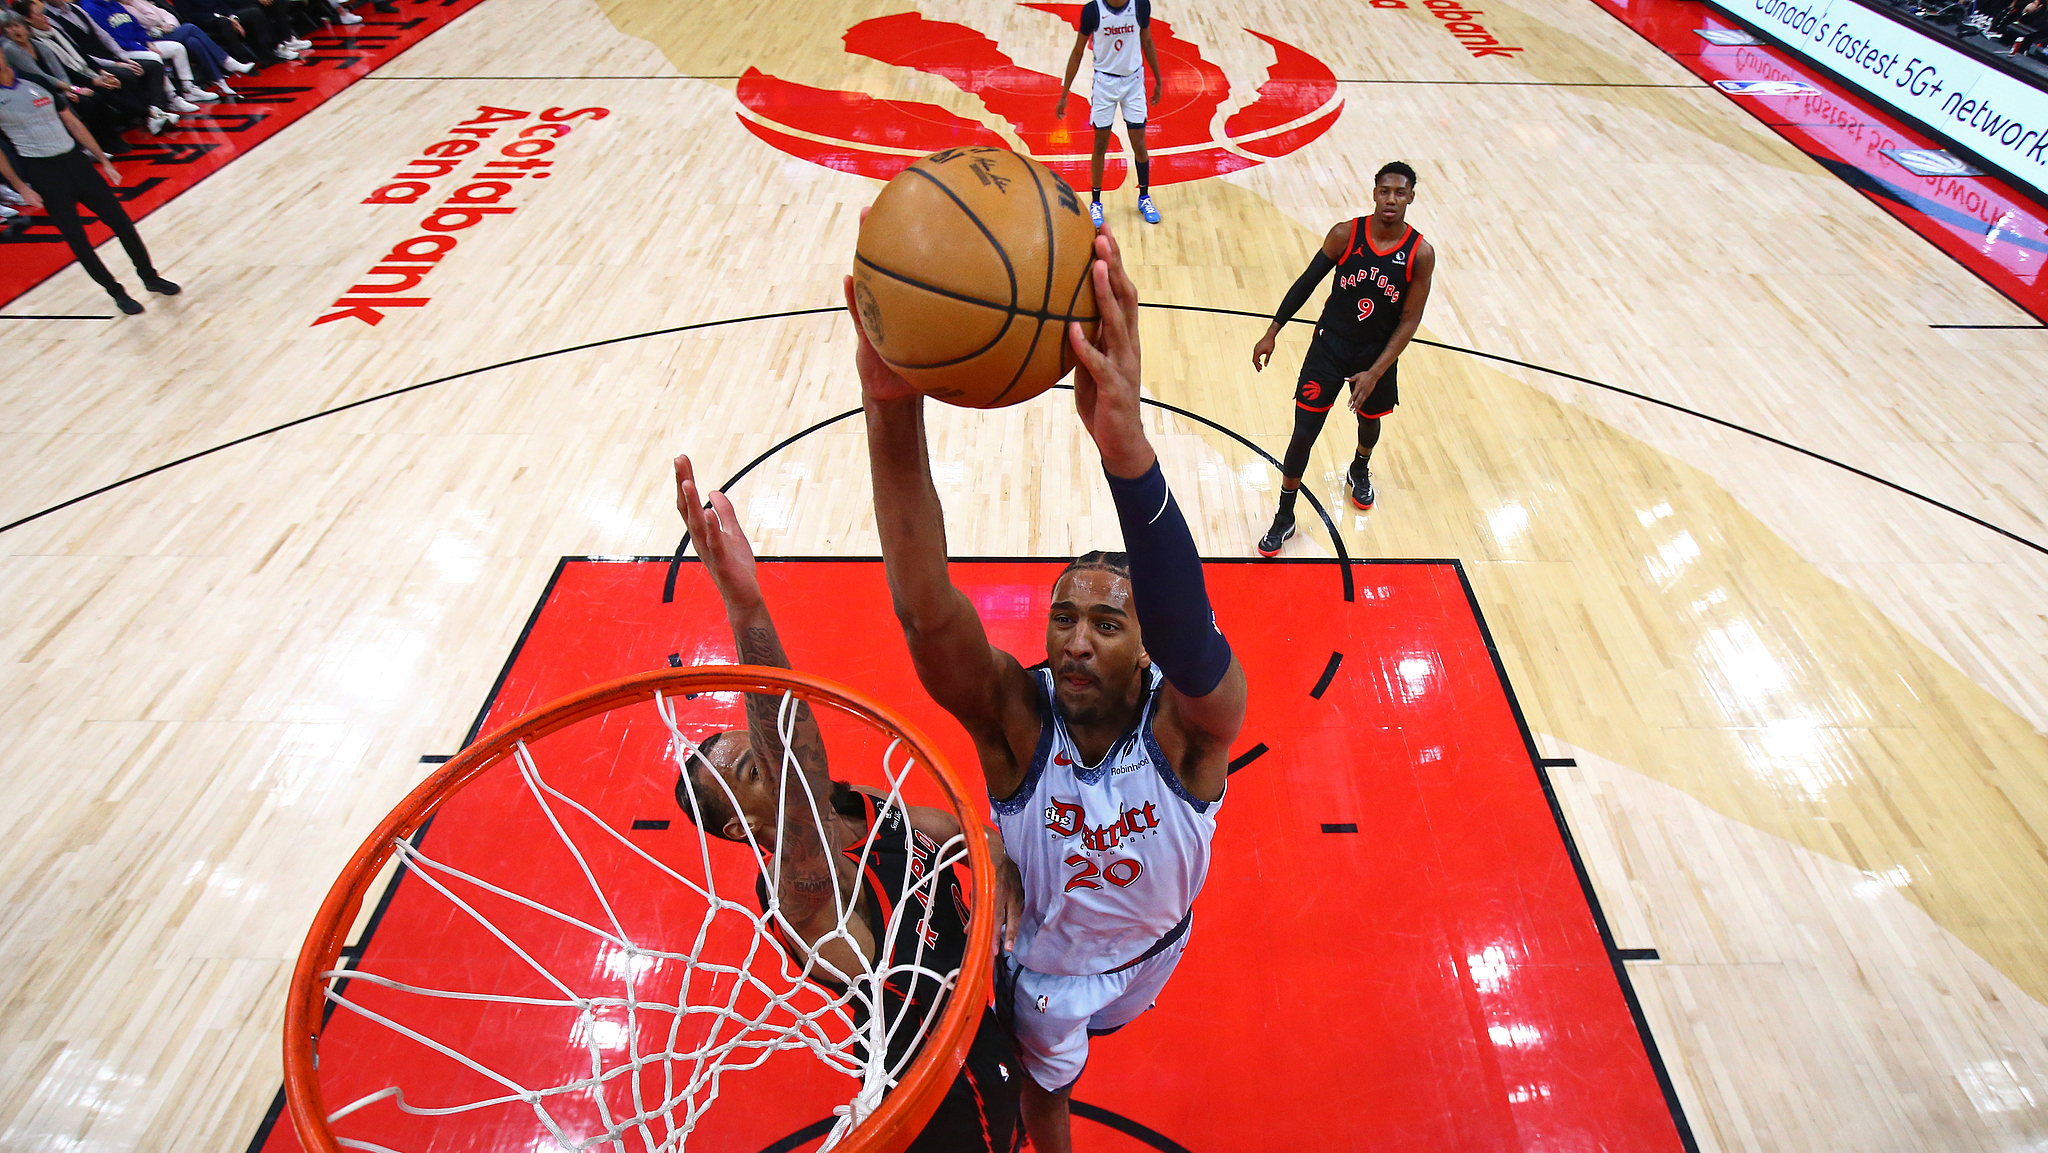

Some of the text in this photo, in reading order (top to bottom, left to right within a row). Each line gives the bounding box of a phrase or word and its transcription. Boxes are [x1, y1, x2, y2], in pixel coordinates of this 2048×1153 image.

[1114, 38, 1124, 52] 0
[1826, 22, 1899, 79] fastest
[1896, 57, 1943, 98] 5G+
[1940, 92, 2048, 166] network.
[360, 105, 531, 204] Arena
[308, 106, 610, 327] Scotiabank
[1340, 266, 1400, 303] RAPTORS
[1357, 298, 1375, 322] 9
[1111, 756, 1150, 776] Robinhood
[1044, 796, 1160, 851] the Dstrict
[1064, 854, 1143, 893] 20
